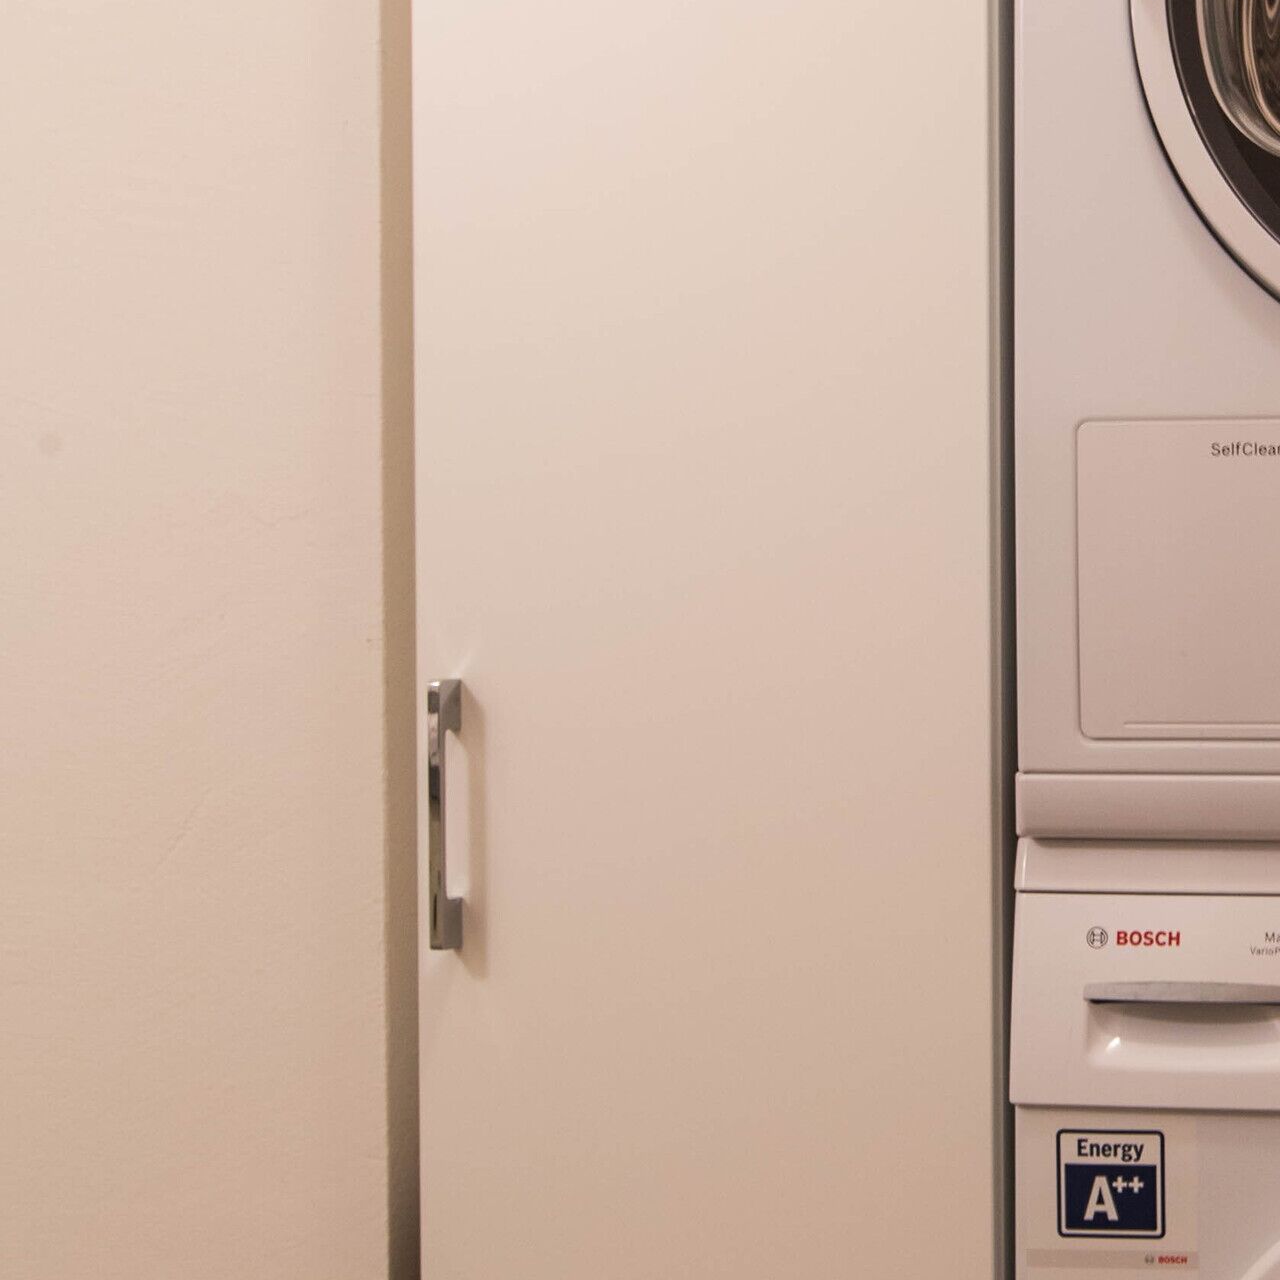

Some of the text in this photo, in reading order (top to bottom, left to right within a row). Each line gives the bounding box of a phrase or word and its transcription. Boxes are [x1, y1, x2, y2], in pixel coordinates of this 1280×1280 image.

[1116, 931, 1181, 946] BOSCH
[1077, 1138, 1144, 1162] Energy
[1083, 1175, 1145, 1221] A++
[1158, 1255, 1188, 1265] BOSCH
